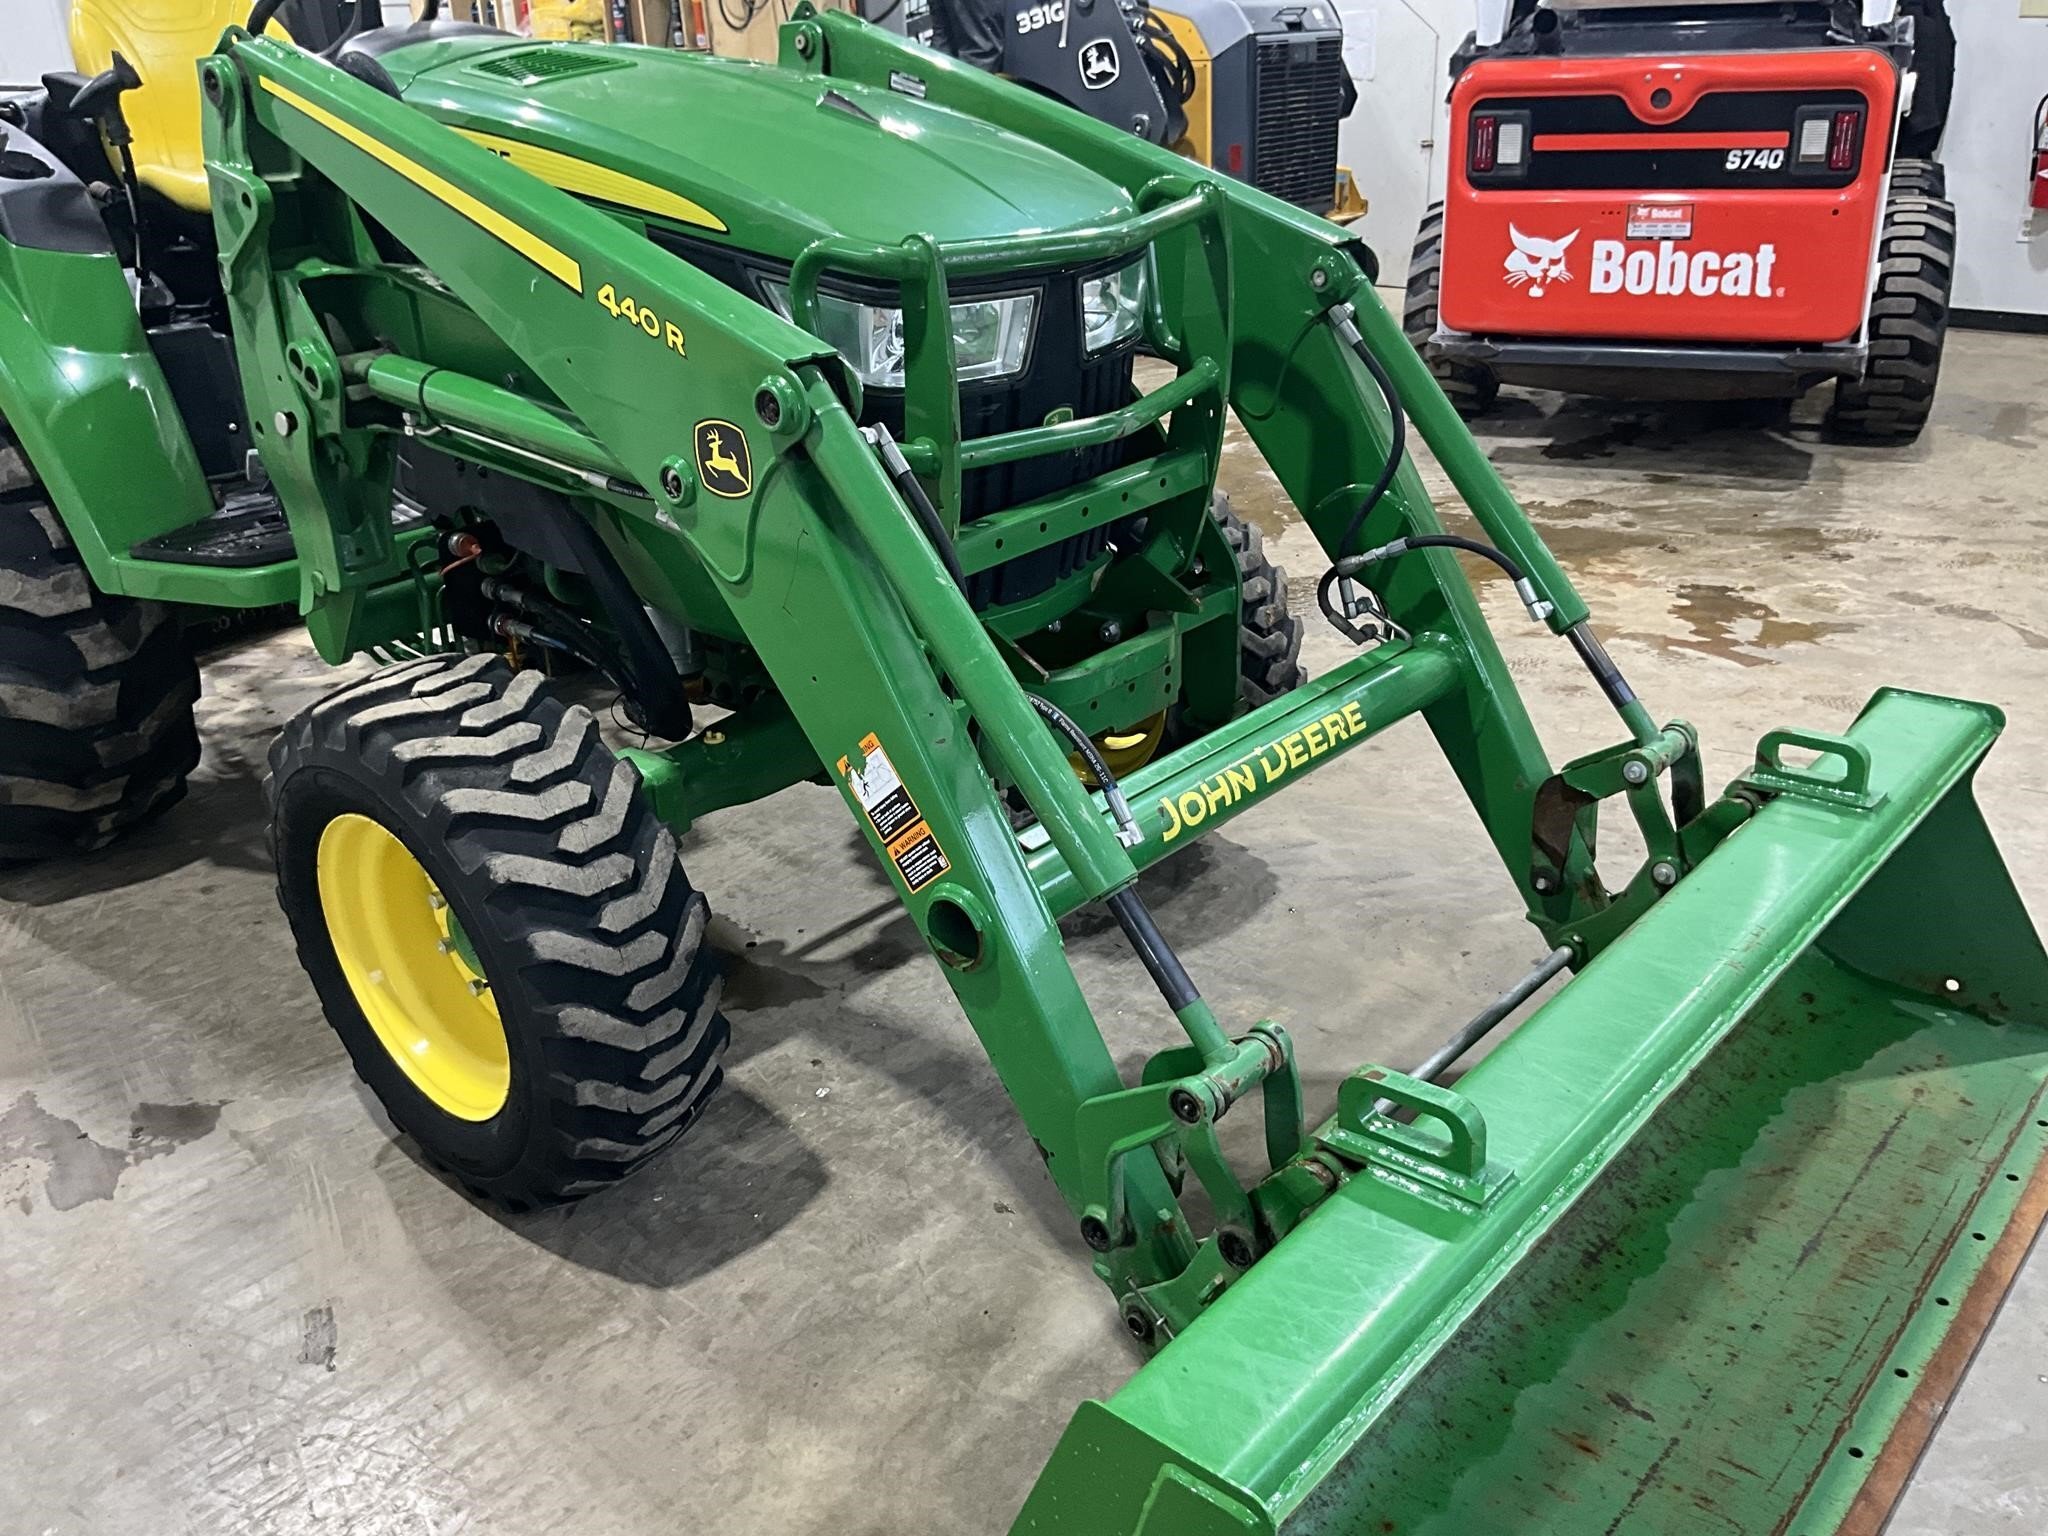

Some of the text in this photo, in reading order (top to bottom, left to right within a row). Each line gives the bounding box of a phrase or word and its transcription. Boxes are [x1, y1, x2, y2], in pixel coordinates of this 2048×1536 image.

[1016, 2, 1065, 34] 331G
[1726, 149, 1785, 171] S740
[1589, 239, 1776, 298] Bobcat
[597, 283, 687, 357] 440 R
[1160, 701, 1367, 843] JOHN DEERE
[900, 827, 926, 851] WARNING
